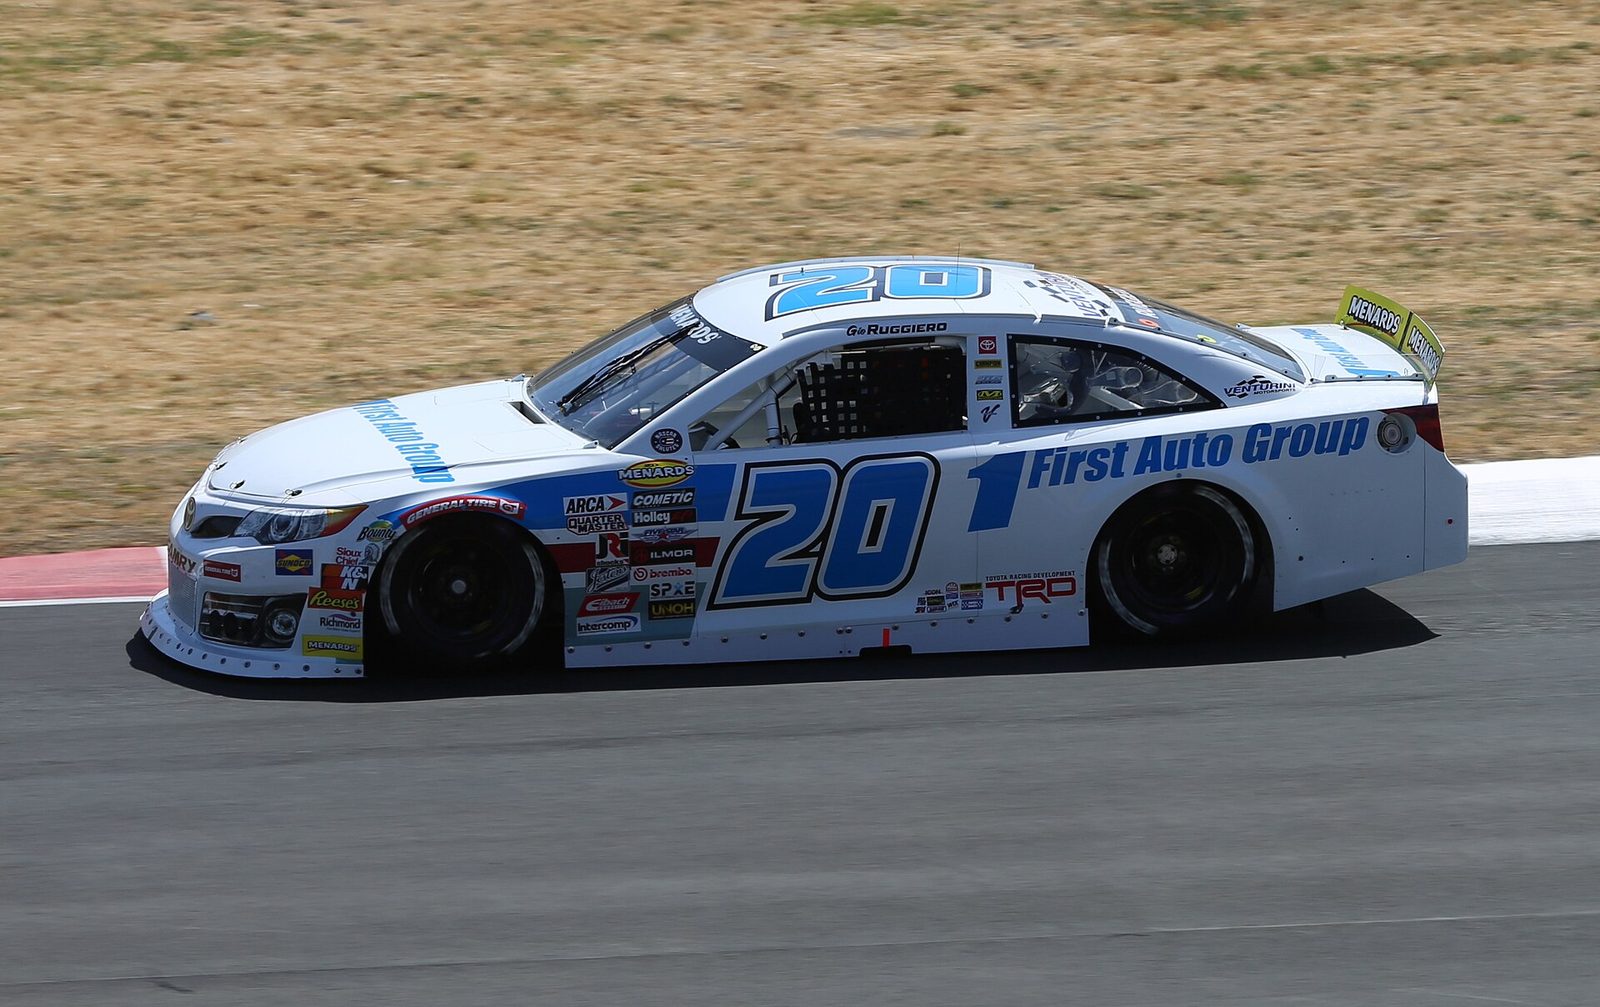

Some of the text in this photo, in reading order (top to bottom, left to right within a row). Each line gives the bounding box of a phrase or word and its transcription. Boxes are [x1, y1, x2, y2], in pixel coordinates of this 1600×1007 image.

[765, 264, 992, 322] 20
[1347, 295, 1401, 336] MENARDS
[847, 322, 948, 337] Gio RUGGIERO
[1407, 325, 1440, 377] MENARDS
[1223, 382, 1296, 395] VENTURINI
[395, 442, 456, 484] Group
[618, 465, 695, 480] MENARDS
[967, 415, 1370, 533] 1 First Auto Group
[566, 497, 605, 514] ARCA
[633, 491, 694, 506] COMETIC
[406, 498, 498, 525] GENERAL TIRE
[633, 510, 671, 525] Holley
[568, 514, 623, 528] QUARTER
[577, 521, 626, 533] MASTER
[356, 526, 397, 542] Bounty
[705, 450, 942, 612] 20
[336, 547, 361, 558] Sioux
[650, 549, 694, 558] ILMOR
[276, 559, 310, 568] SUNOCO
[335, 556, 359, 566] Chief
[650, 567, 692, 578] brembo
[1033, 571, 1076, 579] DEVELOPMENT
[985, 577, 1077, 614] TRD
[651, 602, 694, 615] UNOH
[320, 616, 361, 629] Richmond
[577, 618, 632, 632] Intercomp
[308, 641, 357, 652] MENARDS
